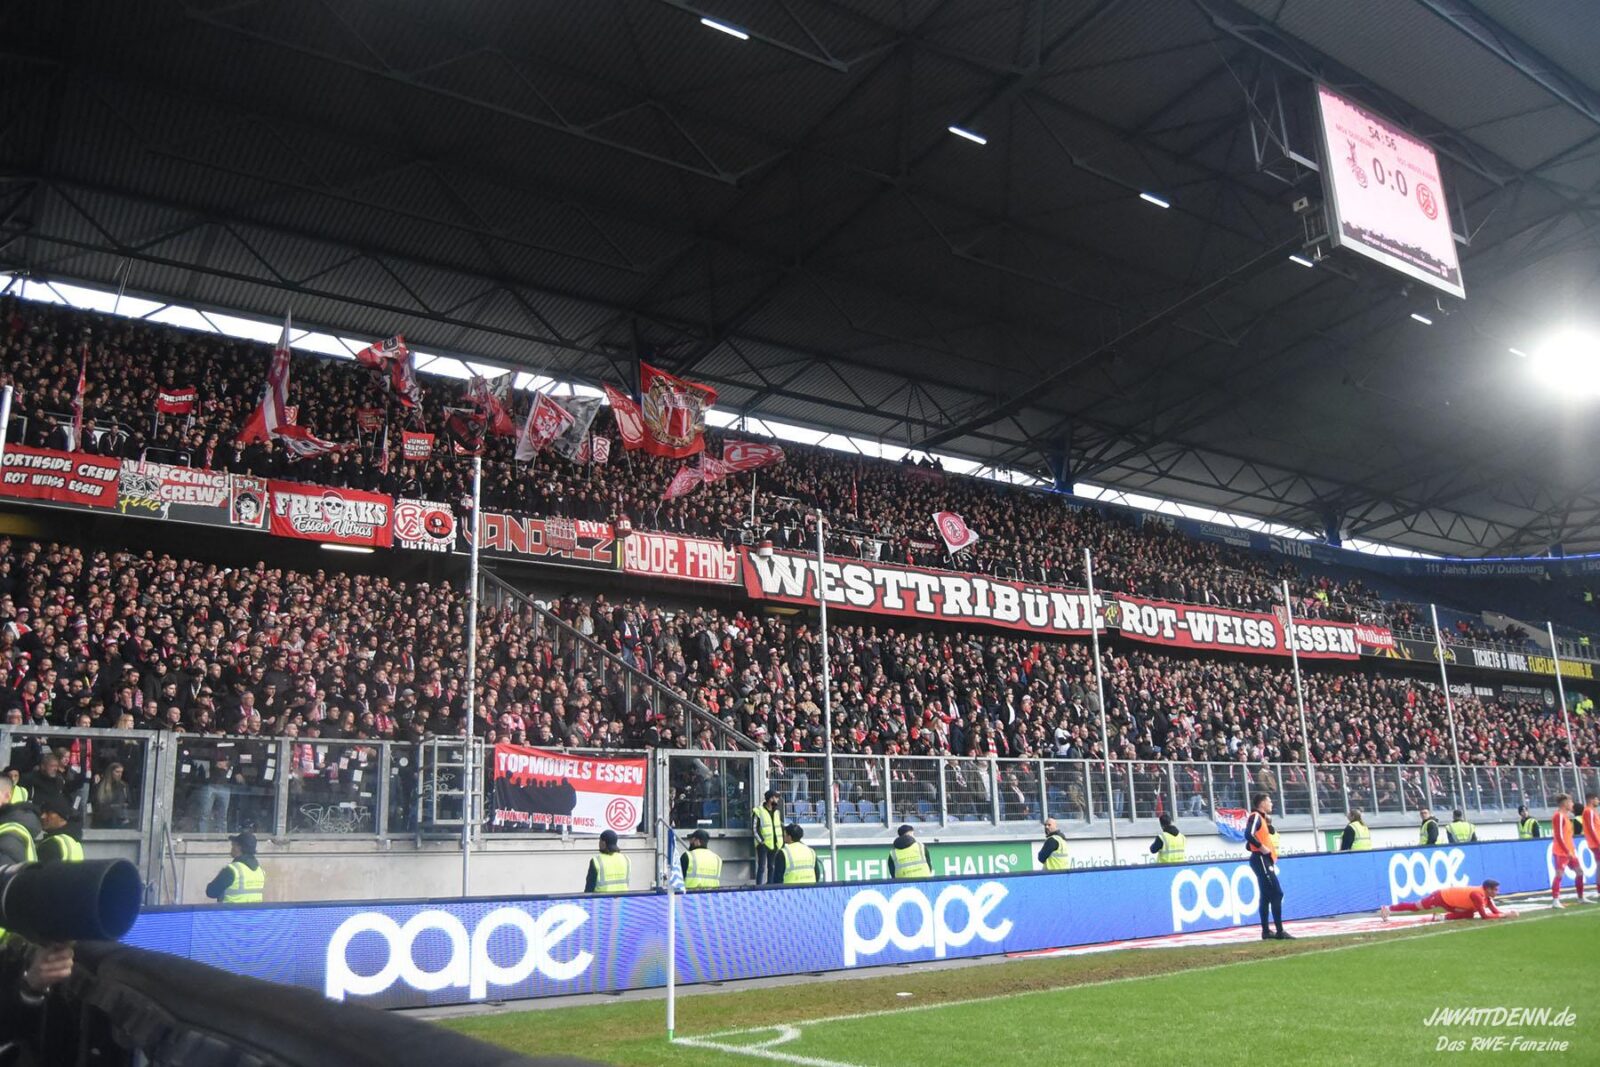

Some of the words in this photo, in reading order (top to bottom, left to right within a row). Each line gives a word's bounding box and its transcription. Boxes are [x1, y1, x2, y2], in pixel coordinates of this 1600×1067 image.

[3, 454, 72, 472] ORTHSIDE
[77, 464, 118, 481] CREW
[4, 472, 28, 483] ROT
[32, 474, 65, 488] WEISS
[68, 480, 103, 496] ESSEN
[160, 484, 220, 503] CREW
[274, 491, 387, 526] FREAKS
[293, 515, 331, 533] Essen
[332, 519, 373, 537] Ultras
[578, 520, 609, 534] RVT
[401, 540, 447, 552] ULTRAS
[625, 534, 679, 574] RUDE
[685, 541, 736, 580] FANS
[1425, 563, 1439, 573] 111
[1442, 565, 1467, 575] Jahre
[1470, 565, 1494, 574] MSV
[1497, 564, 1544, 575] Duisburg
[751, 552, 1105, 630] WESTTRIBÜNE
[1119, 600, 1276, 649] ROT-WEISS
[1473, 648, 1500, 668] TICKETS
[498, 752, 592, 780] TOPMODELS
[596, 763, 643, 785] ESSEN
[553, 814, 572, 825] WEG
[1170, 865, 1280, 931] pap
[843, 881, 1014, 967] pape
[326, 903, 593, 1001] pape
